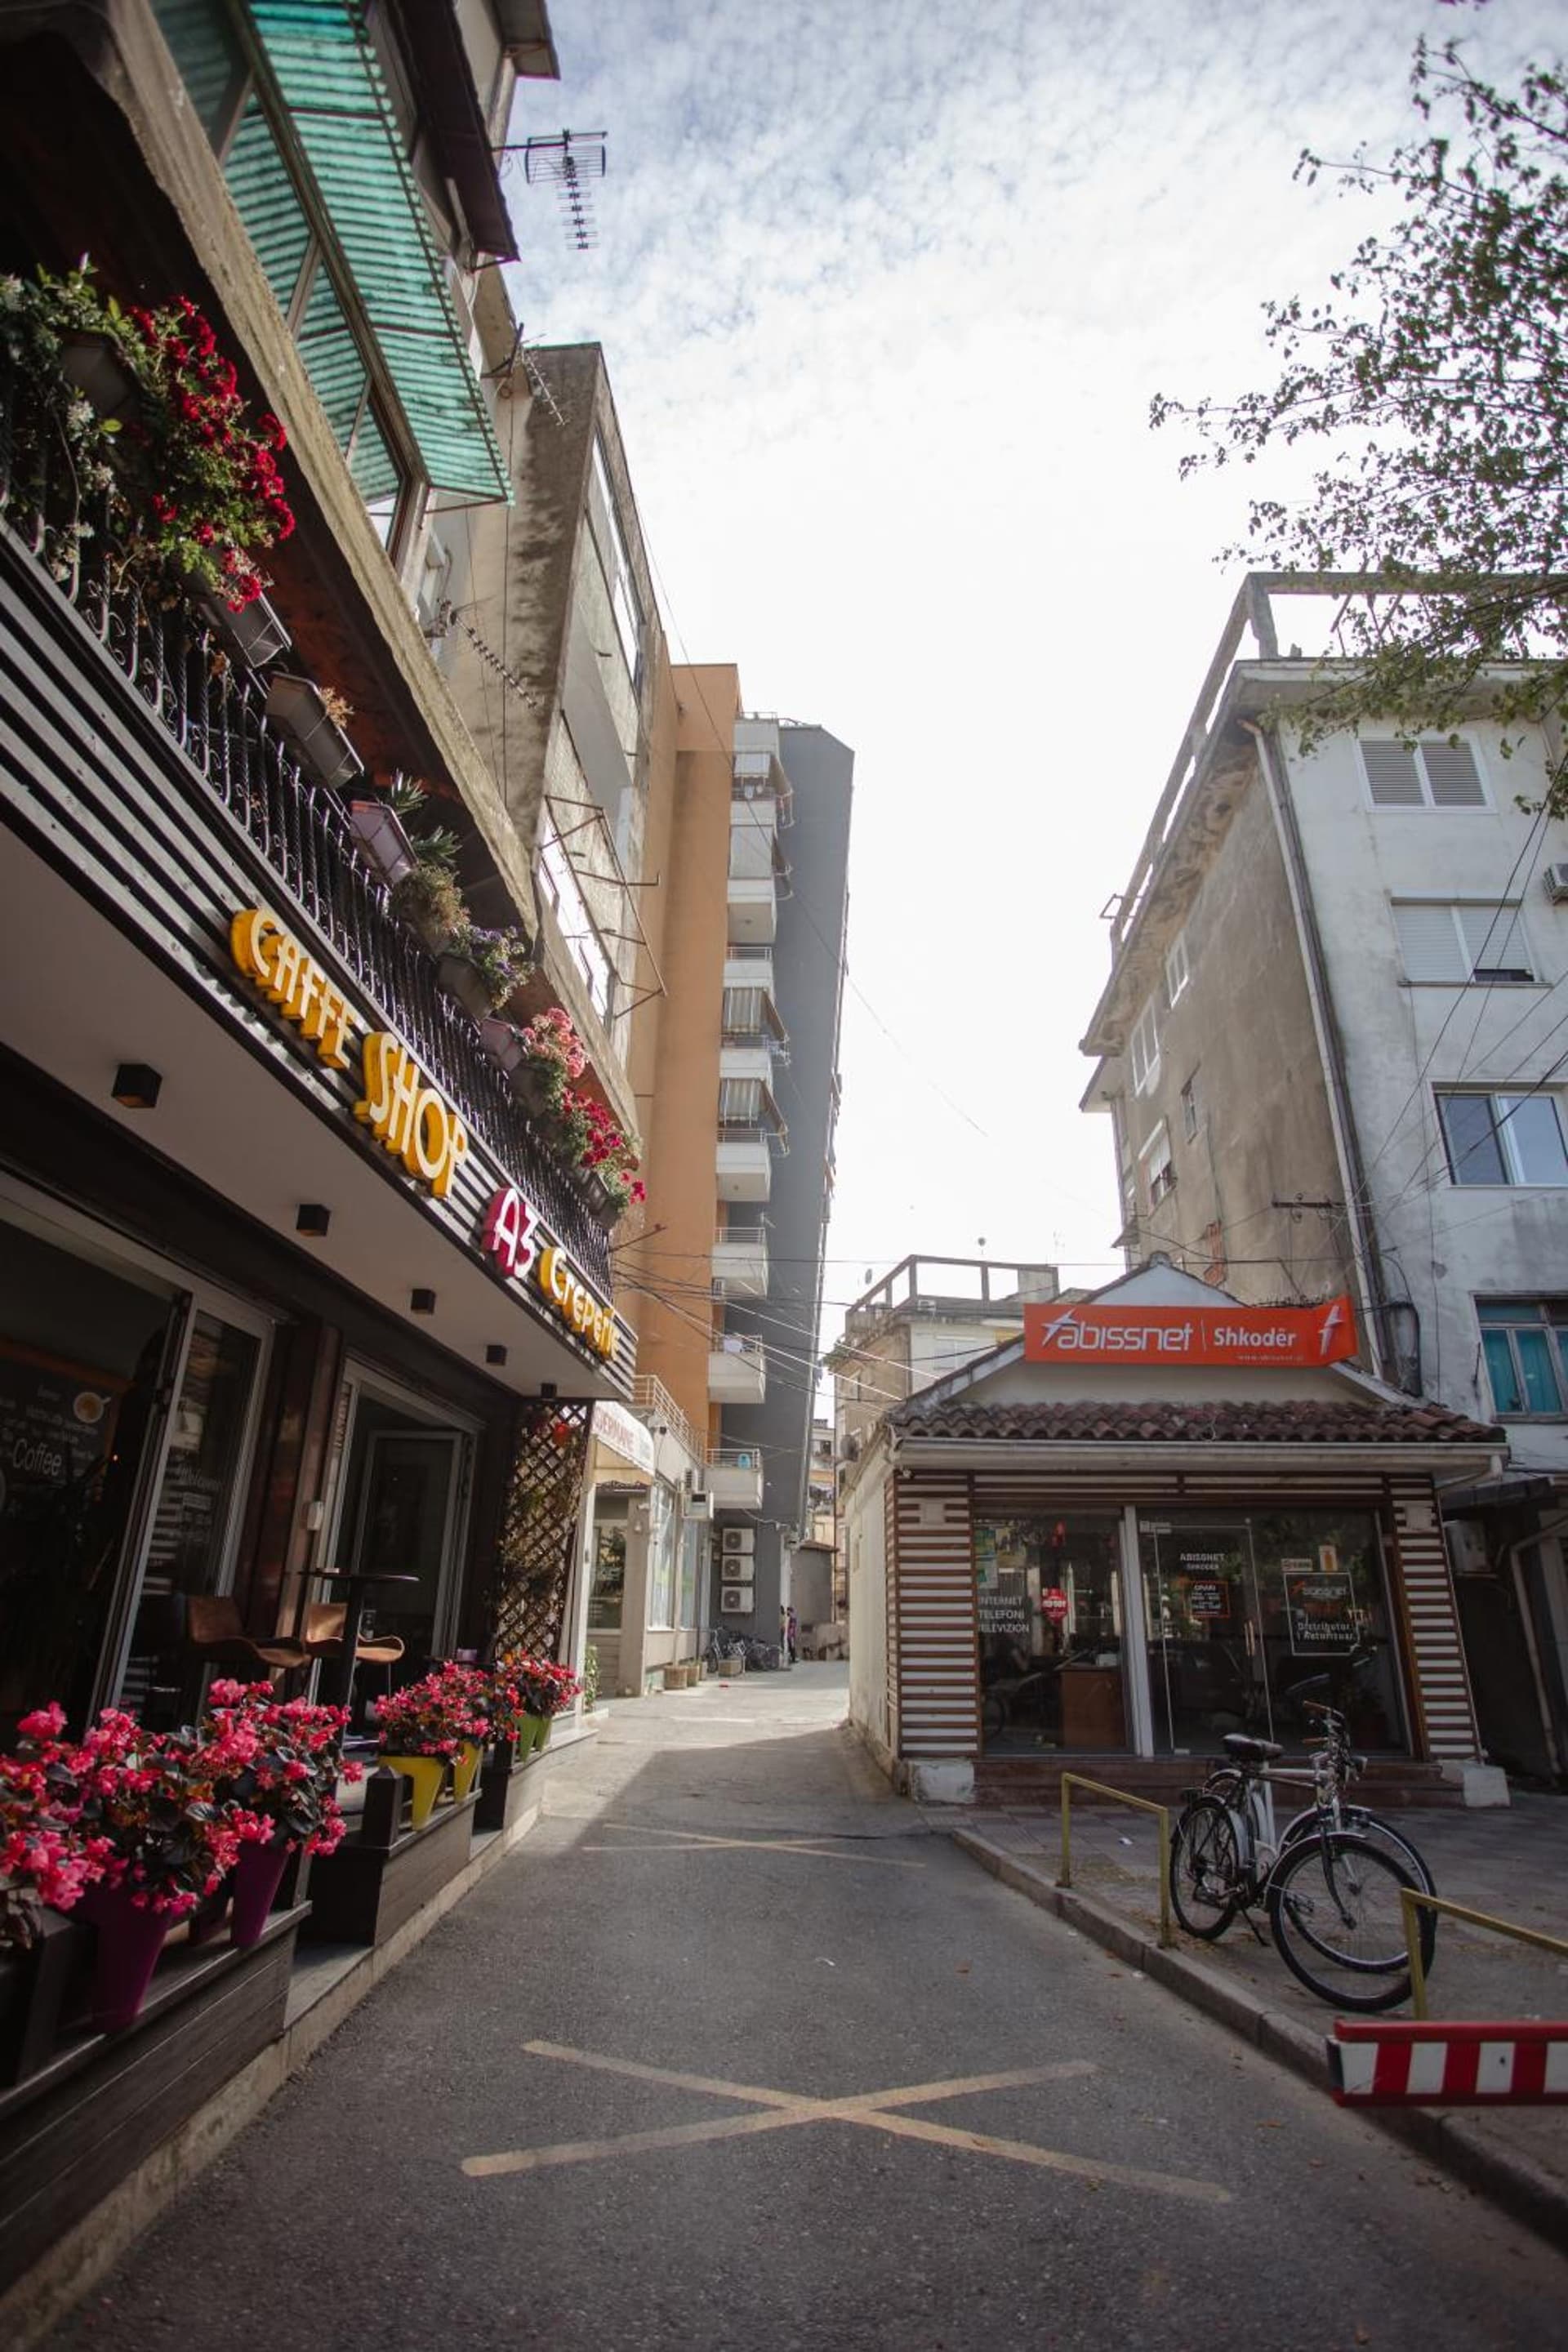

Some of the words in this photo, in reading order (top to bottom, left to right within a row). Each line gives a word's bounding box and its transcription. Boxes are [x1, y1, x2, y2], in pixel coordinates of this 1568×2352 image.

[232, 908, 359, 1071] CAFFE
[354, 1031, 469, 1200] SHOP
[1056, 1321, 1194, 1352] abissnet
[1213, 1327, 1298, 1348] Shkodër
[12, 1437, 63, 1477] Coffee
[979, 1610, 1026, 1619] TELEFONI
